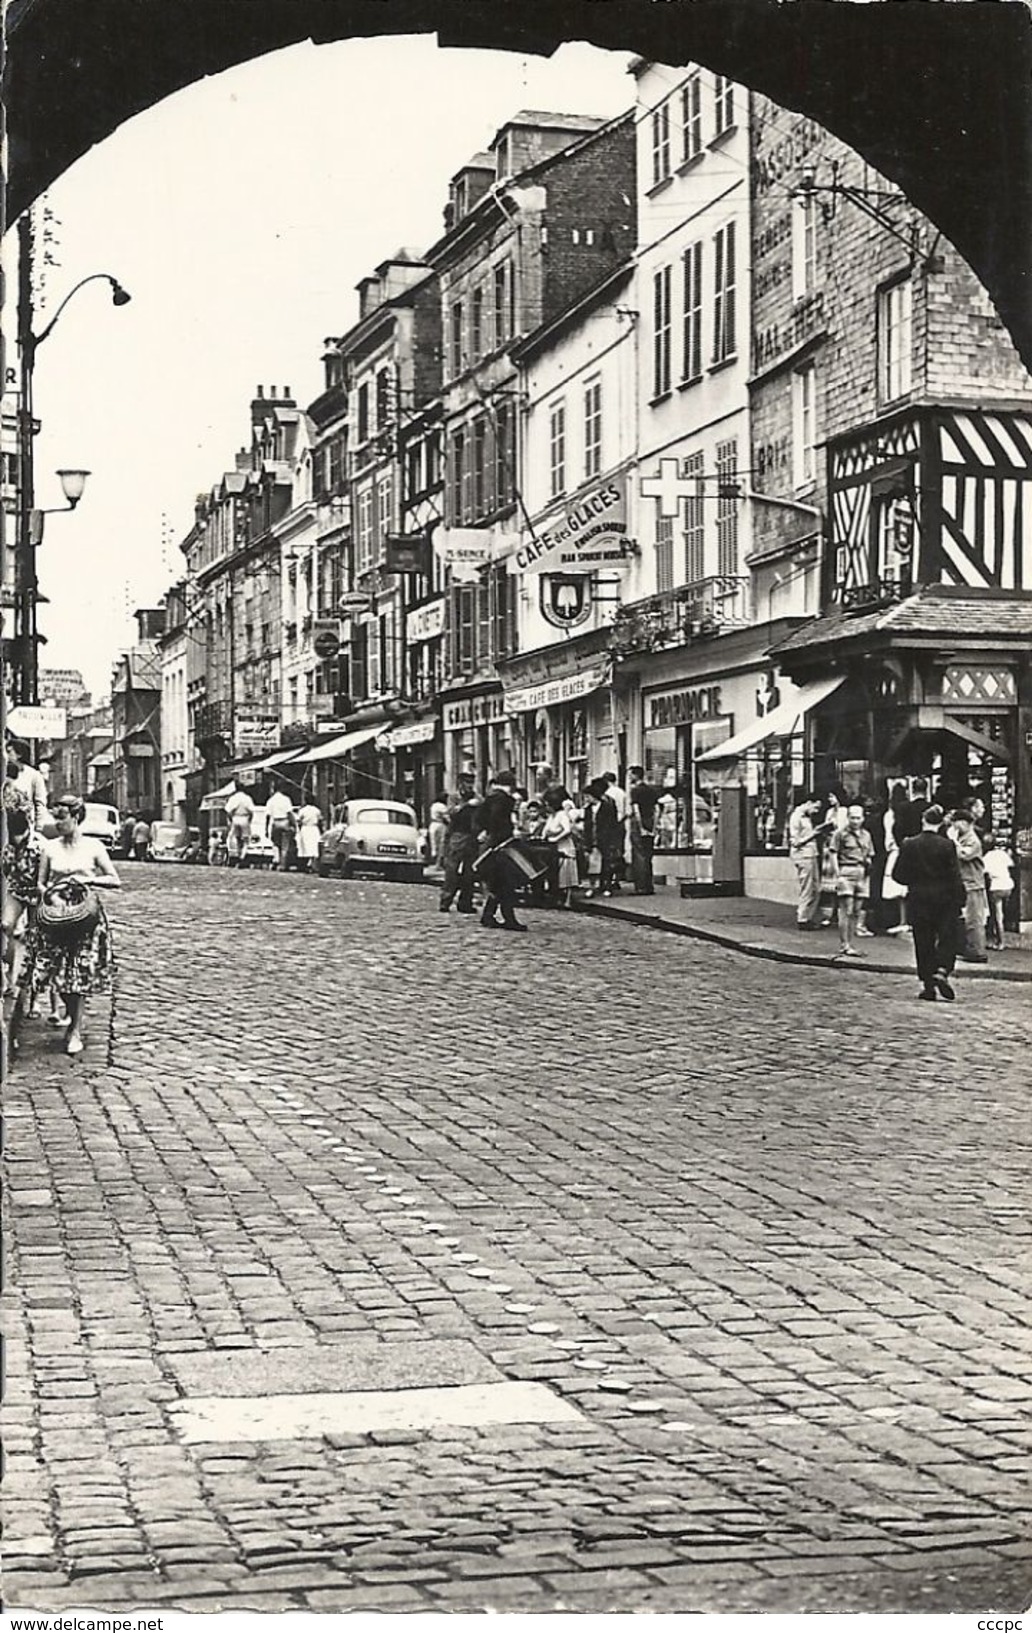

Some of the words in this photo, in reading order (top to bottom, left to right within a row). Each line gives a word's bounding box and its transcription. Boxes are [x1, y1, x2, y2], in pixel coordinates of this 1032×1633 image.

[516, 532, 556, 569] CAFE
[554, 528, 571, 544] des
[567, 484, 621, 532] GLACES
[529, 690, 547, 707] CAFE
[650, 686, 722, 726] PHARMACIE
